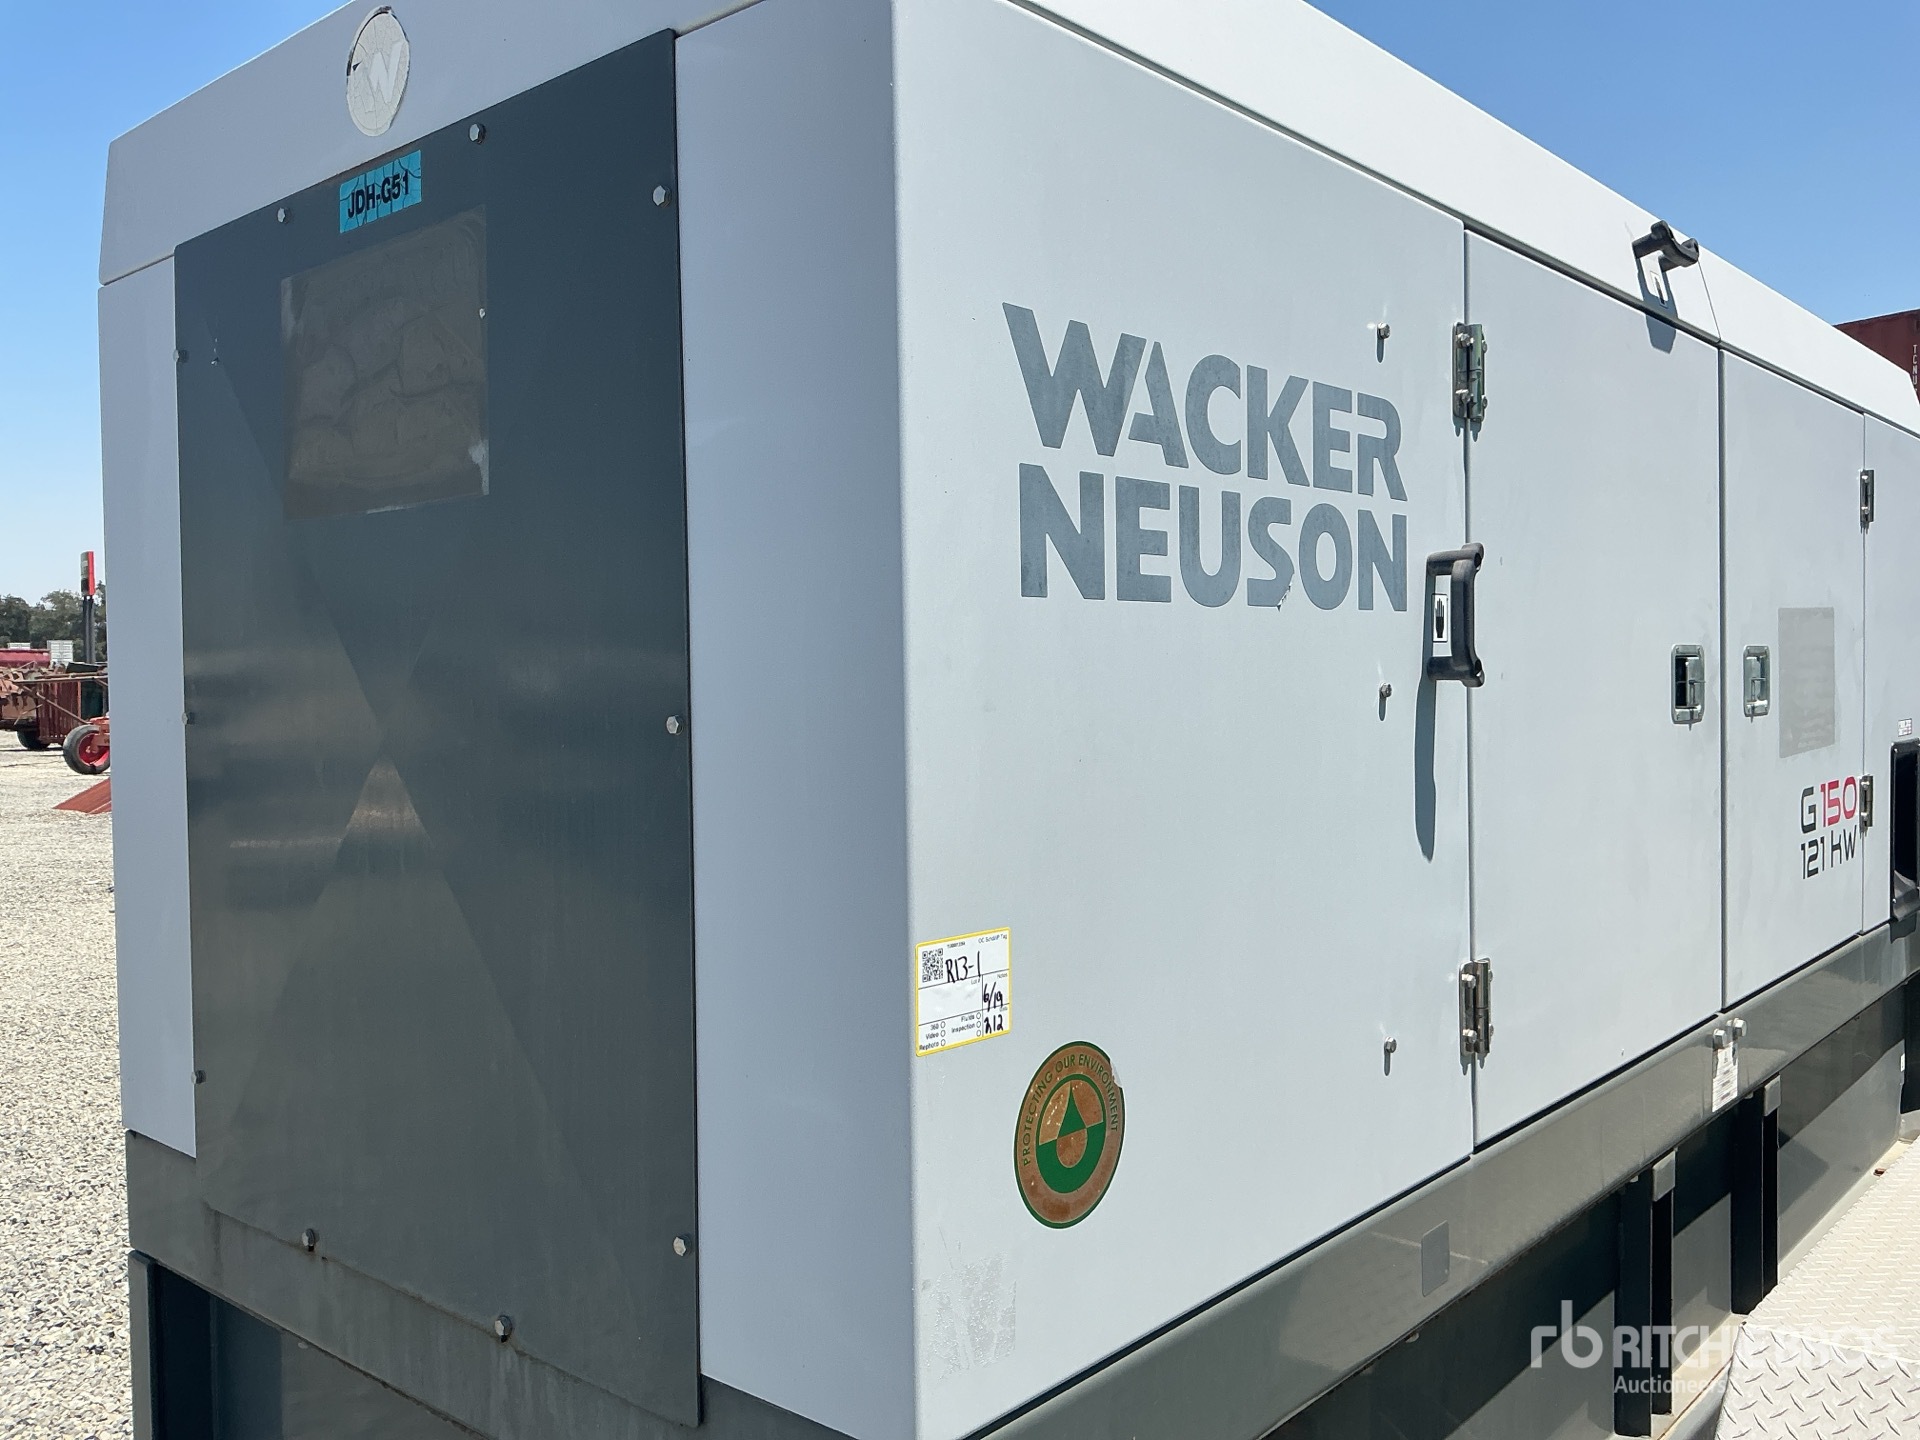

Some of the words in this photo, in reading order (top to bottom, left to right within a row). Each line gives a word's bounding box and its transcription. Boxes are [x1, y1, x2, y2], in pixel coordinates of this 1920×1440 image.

[347, 168, 410, 219] JDH-G51
[1002, 302, 1408, 502] WACKER
[1019, 463, 1408, 612] NEUSON
[1800, 786, 1817, 834] G
[1820, 776, 1857, 828] 150
[1800, 836, 1825, 880] 121
[945, 950, 981, 983] R13-1
[983, 981, 1004, 1012] 6/19
[926, 1031, 939, 1039] Video
[1022, 1073, 1053, 1167] PROTECTING
[1055, 1053, 1076, 1074] OUR
[1078, 1053, 1118, 1132] ENVIRONMENT
